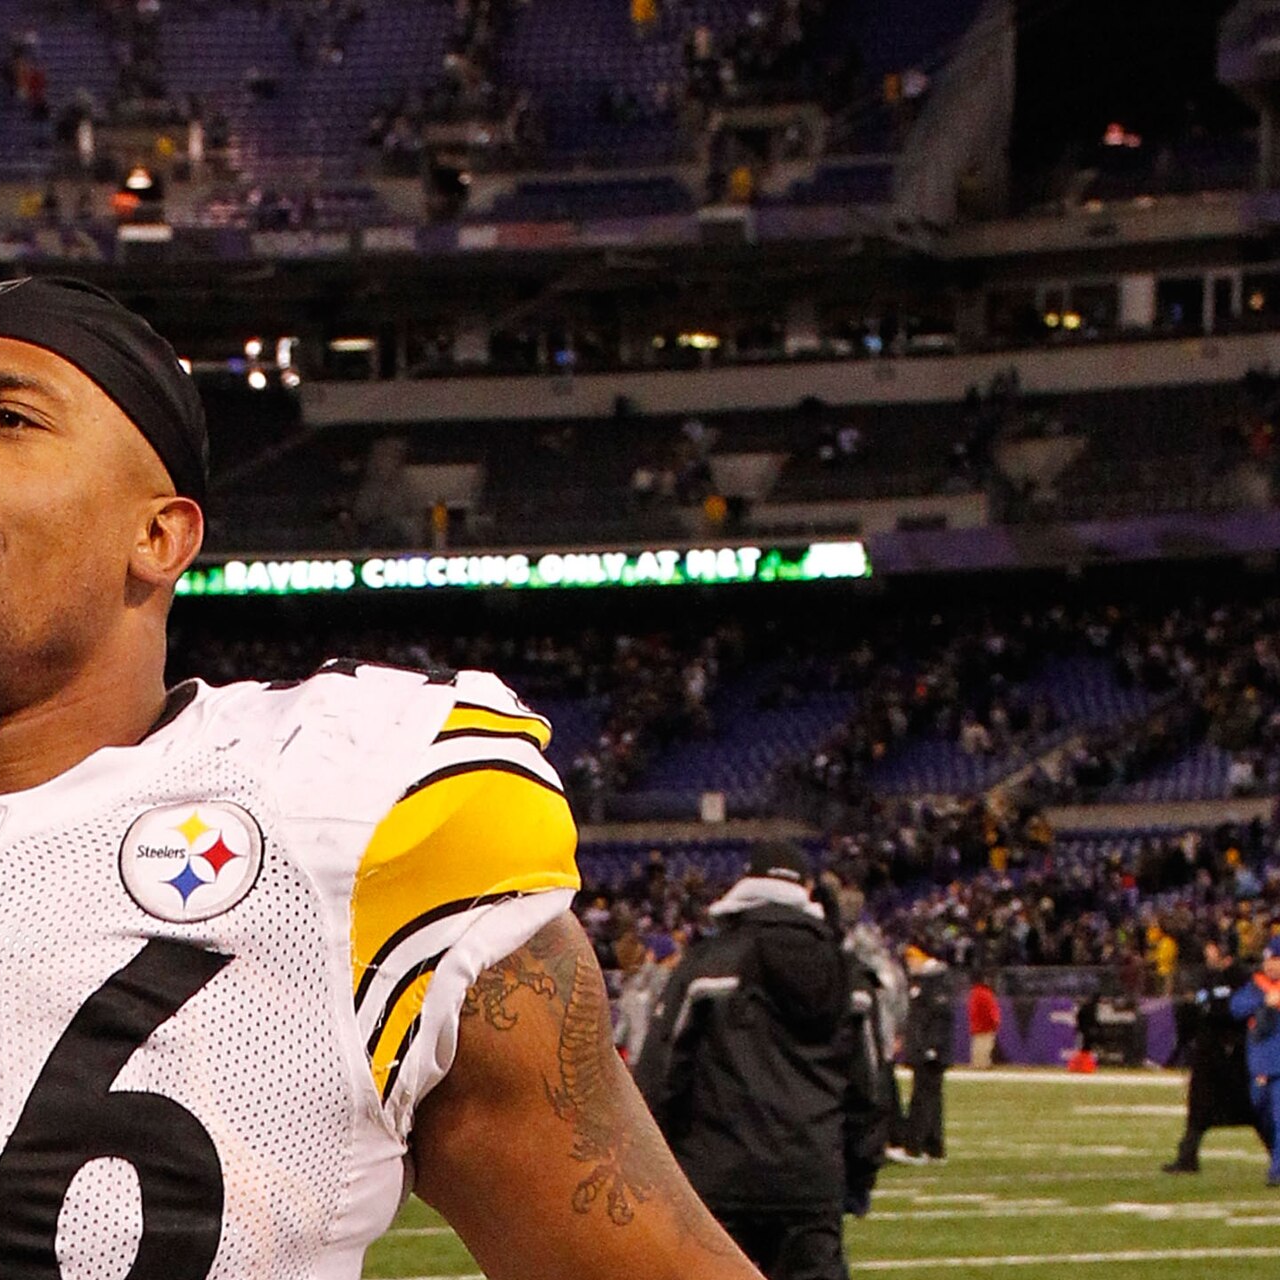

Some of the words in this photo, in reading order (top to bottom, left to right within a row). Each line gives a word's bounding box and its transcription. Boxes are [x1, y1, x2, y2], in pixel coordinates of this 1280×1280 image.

[224, 560, 355, 590] RAVENS
[361, 554, 530, 589] CHECKING
[537, 552, 626, 584] ONLY
[637, 550, 680, 581] AT
[136, 844, 186, 860] Steelers
